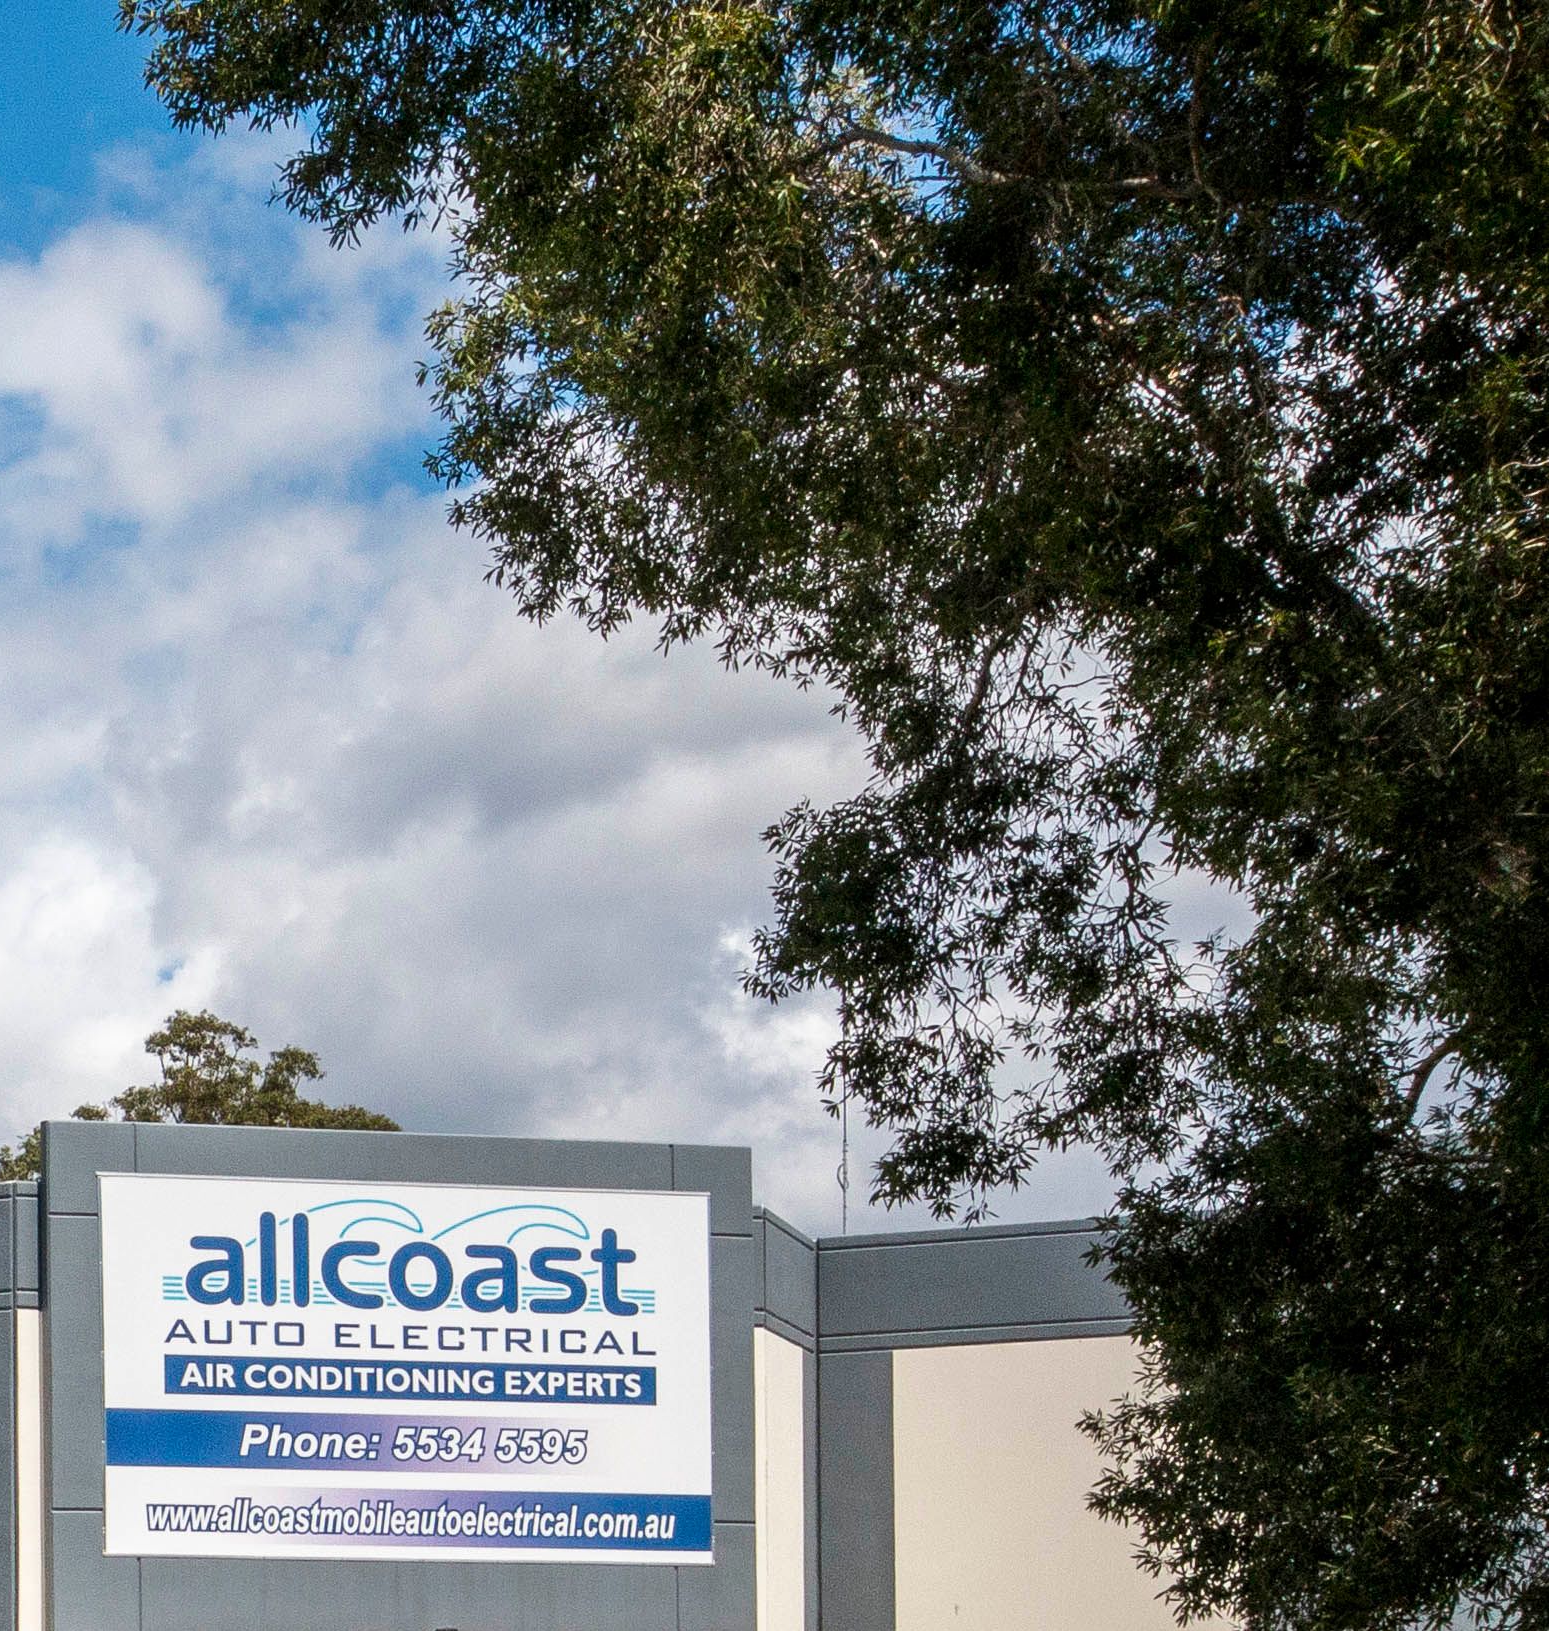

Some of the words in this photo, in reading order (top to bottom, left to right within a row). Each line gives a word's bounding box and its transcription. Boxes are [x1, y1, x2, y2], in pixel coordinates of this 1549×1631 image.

[185, 1211, 641, 1317] allcoast
[164, 1318, 305, 1346] AUTO
[334, 1323, 657, 1356] ELECTRICAL
[180, 1361, 236, 1389] AIR
[244, 1363, 495, 1395] CONDITIONING
[504, 1368, 642, 1398] EXPERTS
[239, 1422, 379, 1461] Phone:
[391, 1427, 485, 1463] 5534
[494, 1428, 589, 1464] 5595
[147, 1497, 676, 1540] www.allcoastmobileautoelectrical.com.au
